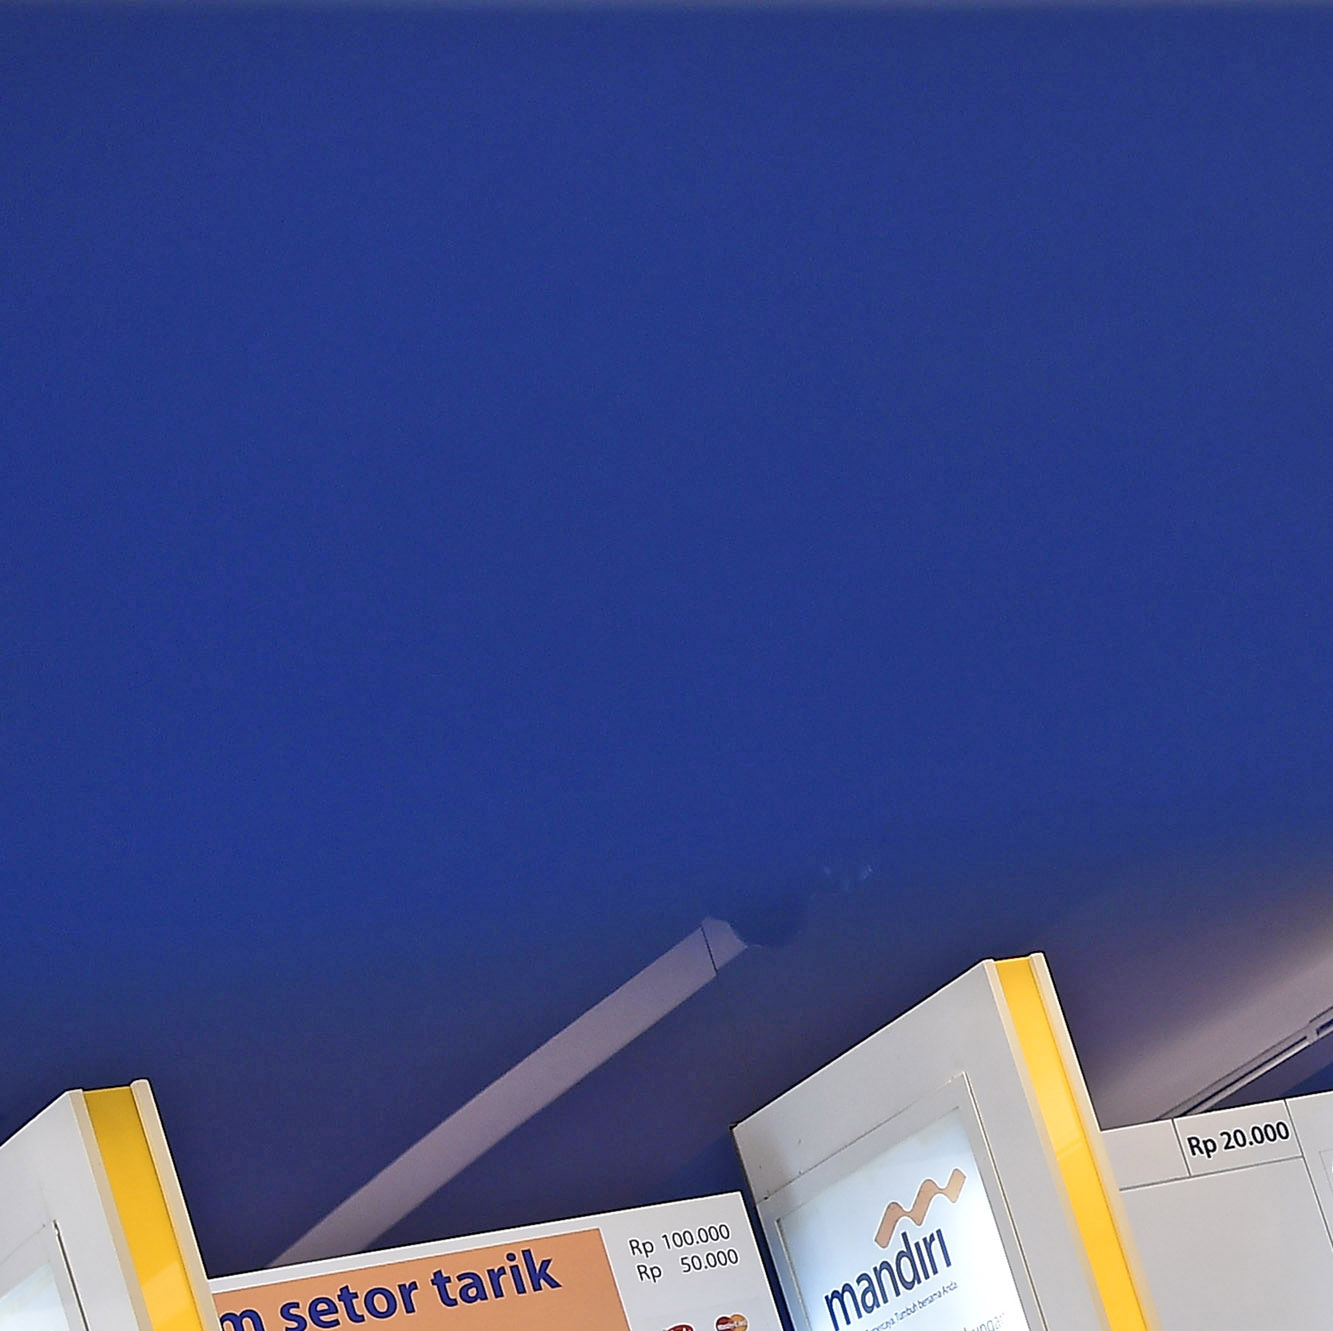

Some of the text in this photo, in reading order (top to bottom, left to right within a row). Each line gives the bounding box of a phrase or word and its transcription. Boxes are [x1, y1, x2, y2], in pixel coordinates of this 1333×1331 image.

[1187, 1121, 1290, 1158] Rp 20.000
[628, 1224, 731, 1259] Rp 100.000
[431, 1247, 562, 1308] tarik
[636, 1248, 739, 1284] Rp 50.000
[824, 1228, 952, 1331] mandiri
